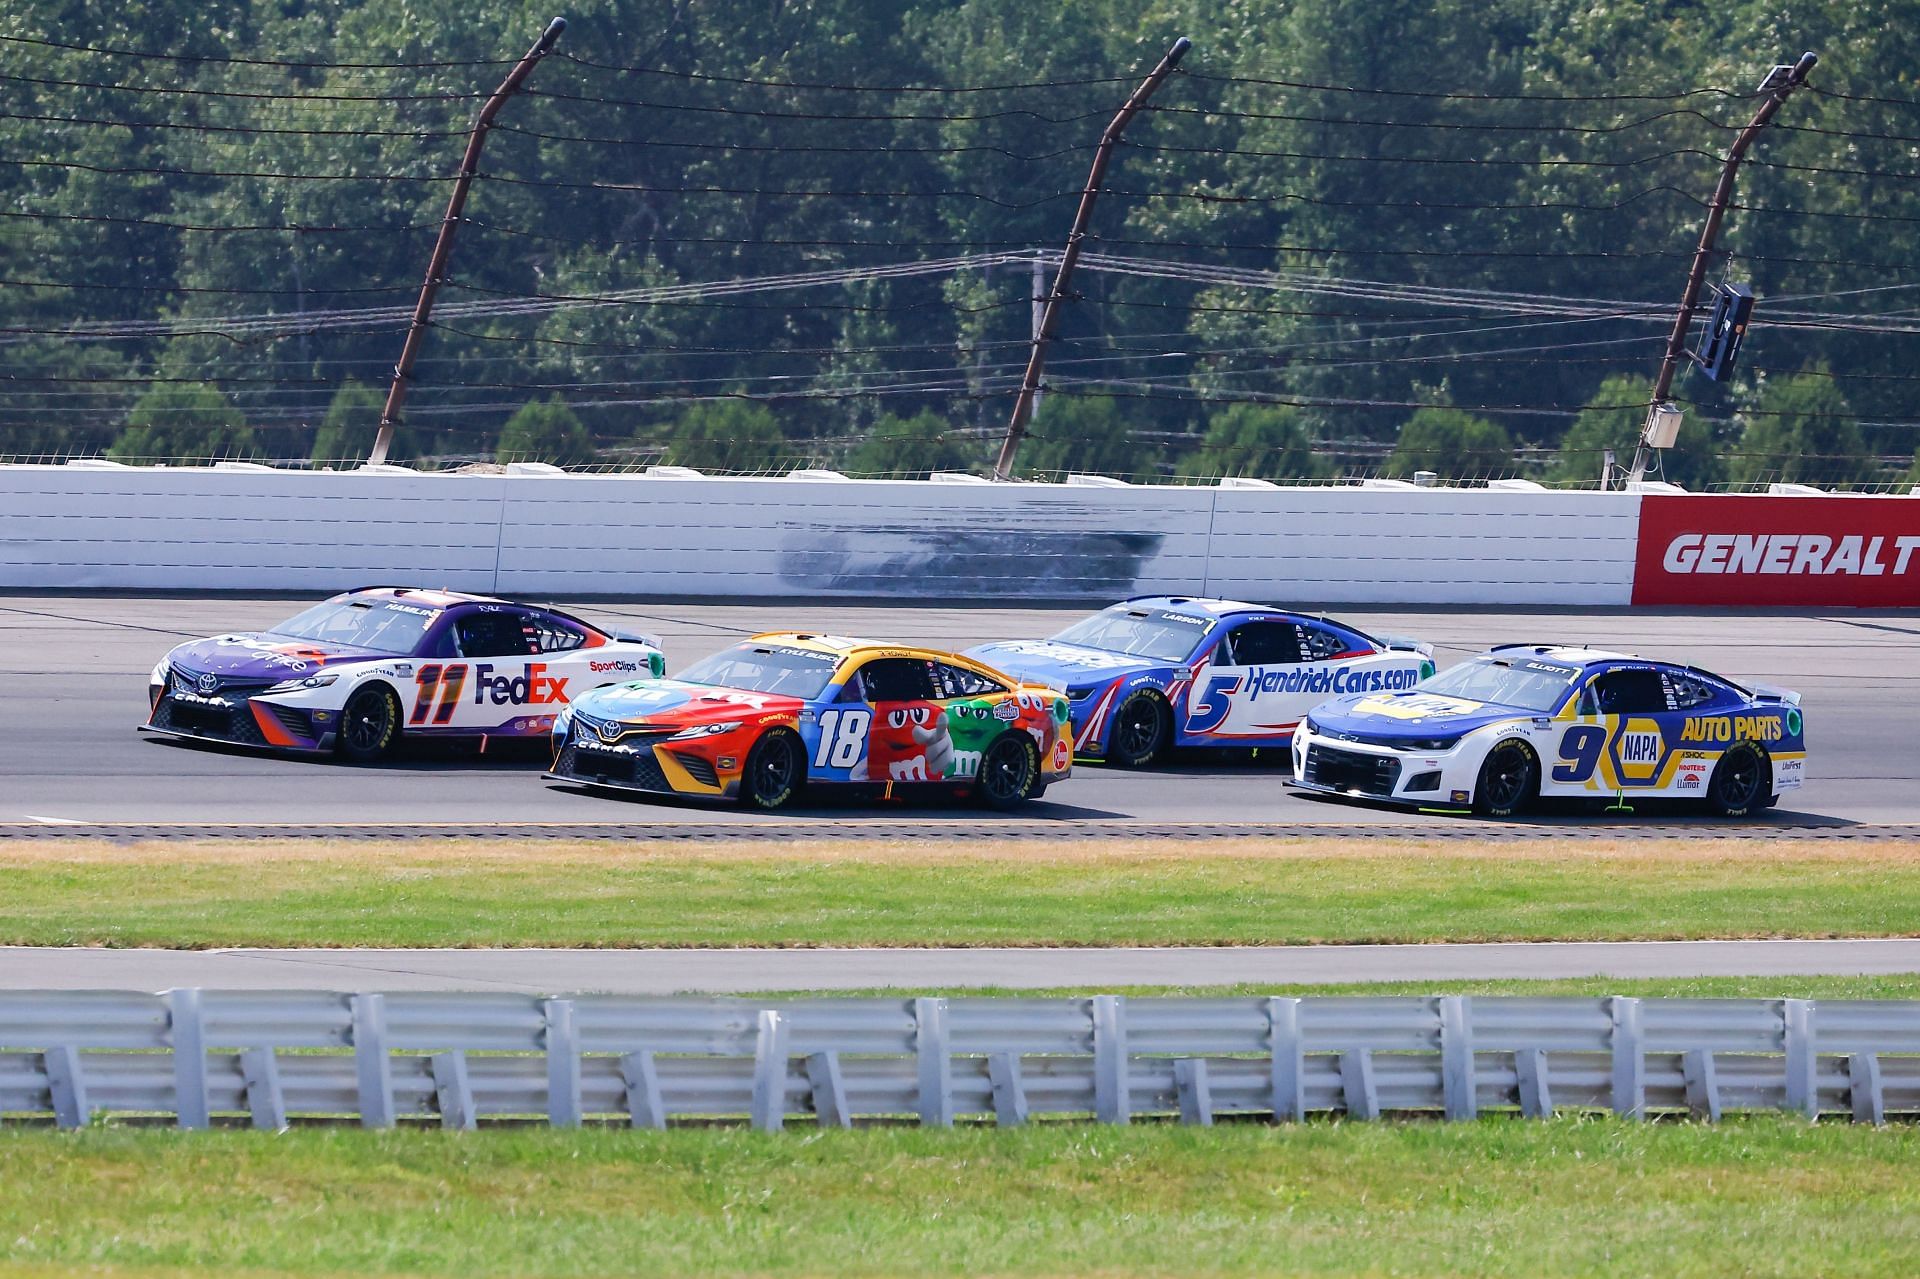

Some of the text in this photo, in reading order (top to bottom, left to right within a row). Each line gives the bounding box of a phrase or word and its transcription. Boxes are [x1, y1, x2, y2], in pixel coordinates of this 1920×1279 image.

[1663, 534, 1884, 576] GENERAL
[1161, 613, 1204, 625] LARSON
[475, 663, 570, 704] FedEx
[1244, 666, 1418, 702] HendrickCars.com
[1526, 662, 1570, 674] ELLIOTT
[408, 663, 468, 725] 11
[1184, 673, 1244, 734] 5
[814, 710, 872, 768] 18
[1680, 715, 1782, 742] AUTO PARTS
[1551, 724, 1607, 784] 9
[1623, 734, 1657, 762] NAPA
[1678, 764, 1706, 772] HOOTERS
